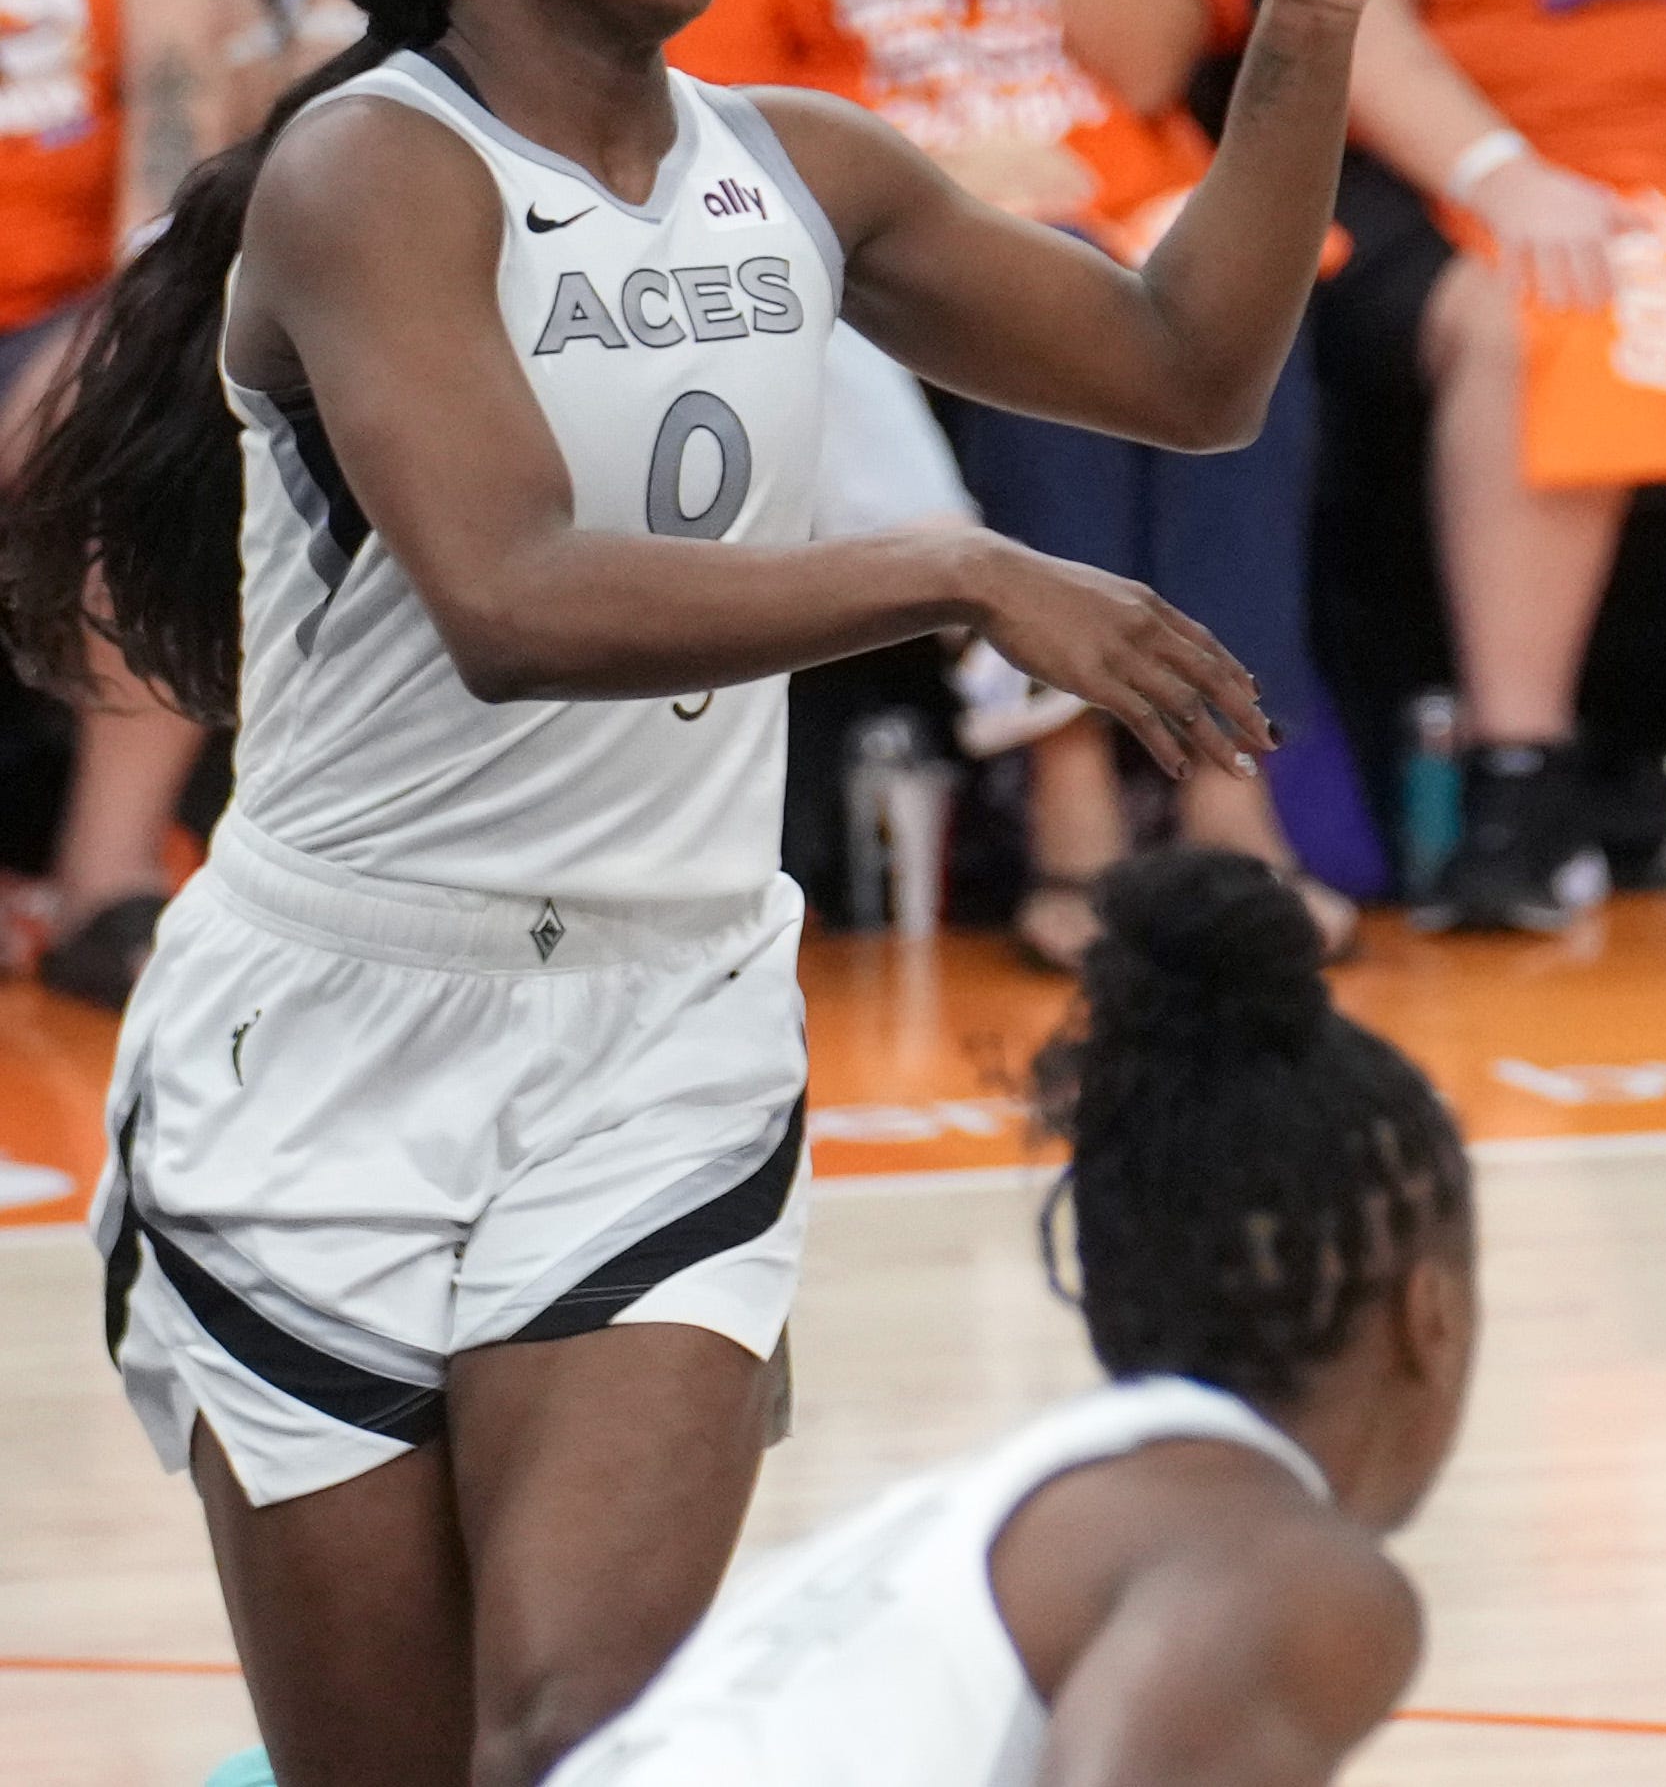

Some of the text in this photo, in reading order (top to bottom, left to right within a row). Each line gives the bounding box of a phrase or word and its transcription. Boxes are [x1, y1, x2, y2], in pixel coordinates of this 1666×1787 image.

[704, 178, 768, 221] ally
[532, 256, 804, 356] ACES
[645, 390, 752, 540] 0
